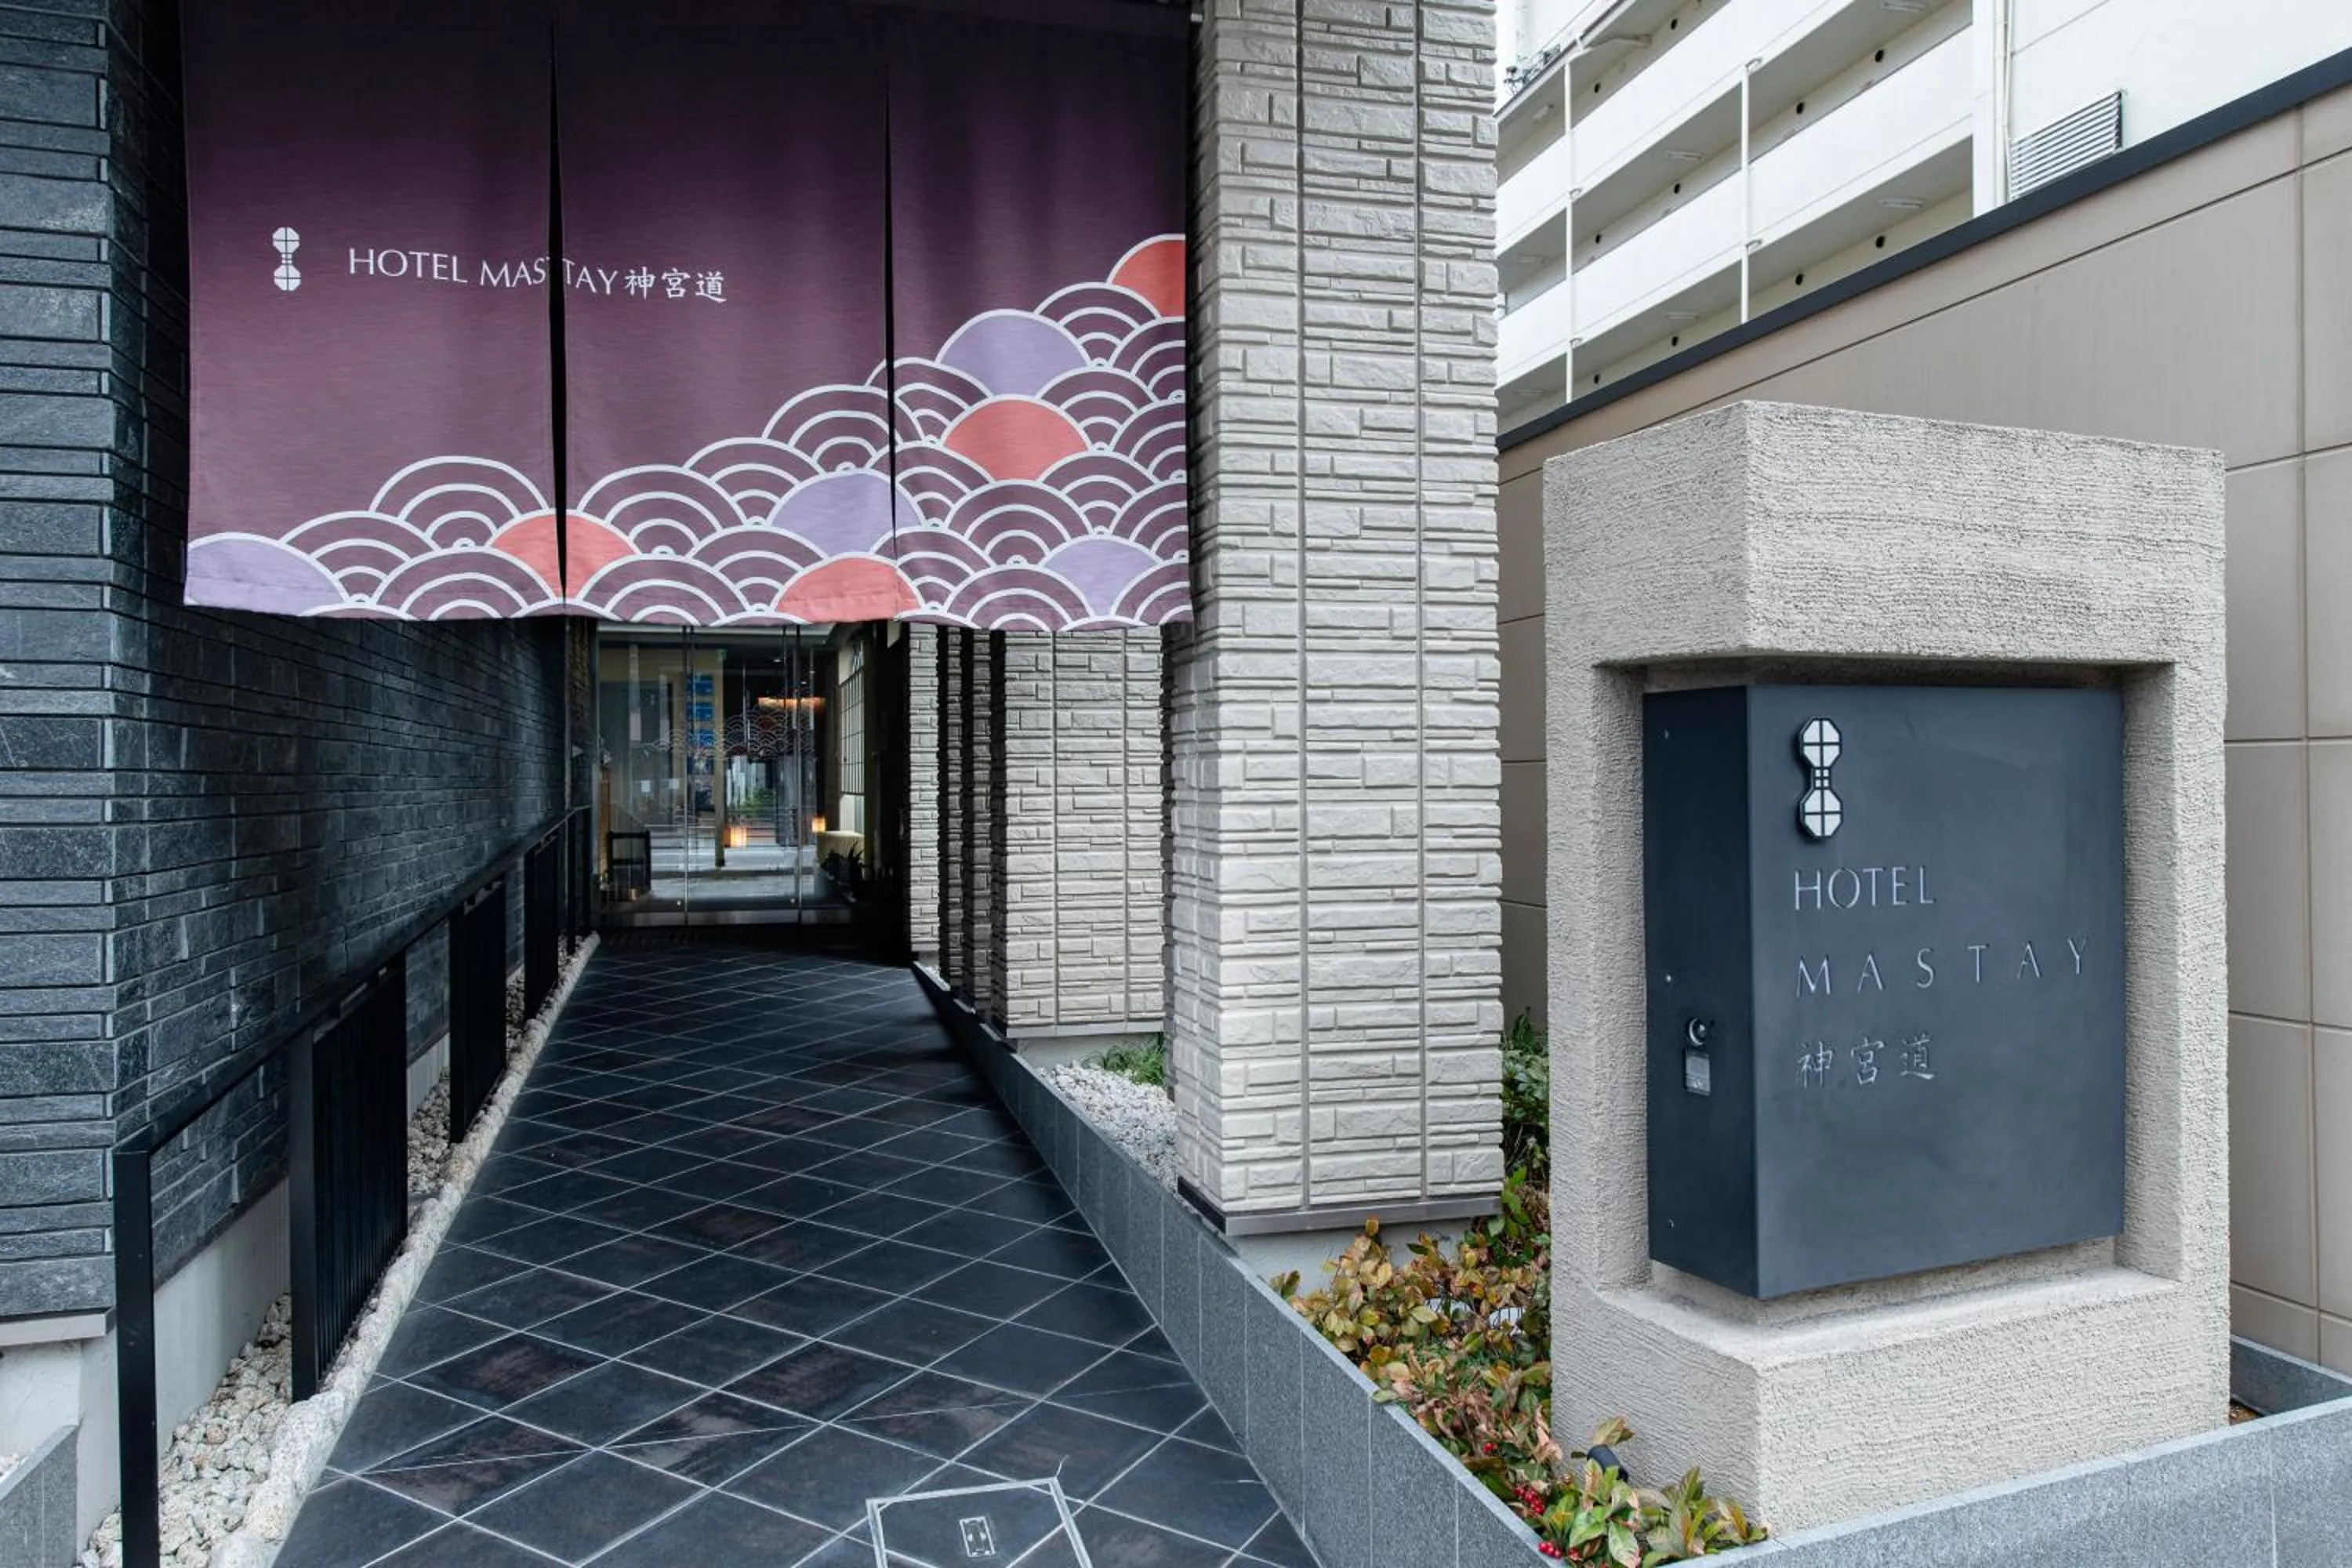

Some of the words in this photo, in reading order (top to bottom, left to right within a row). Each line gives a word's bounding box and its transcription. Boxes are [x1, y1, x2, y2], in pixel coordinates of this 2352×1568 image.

[348, 248, 467, 283] HOTEL
[624, 267, 726, 303] 神宮道
[1794, 866, 1935, 910] HOTEL
[1796, 938, 2089, 999] MASTAY
[1797, 1031, 1938, 1090] 神宮道
